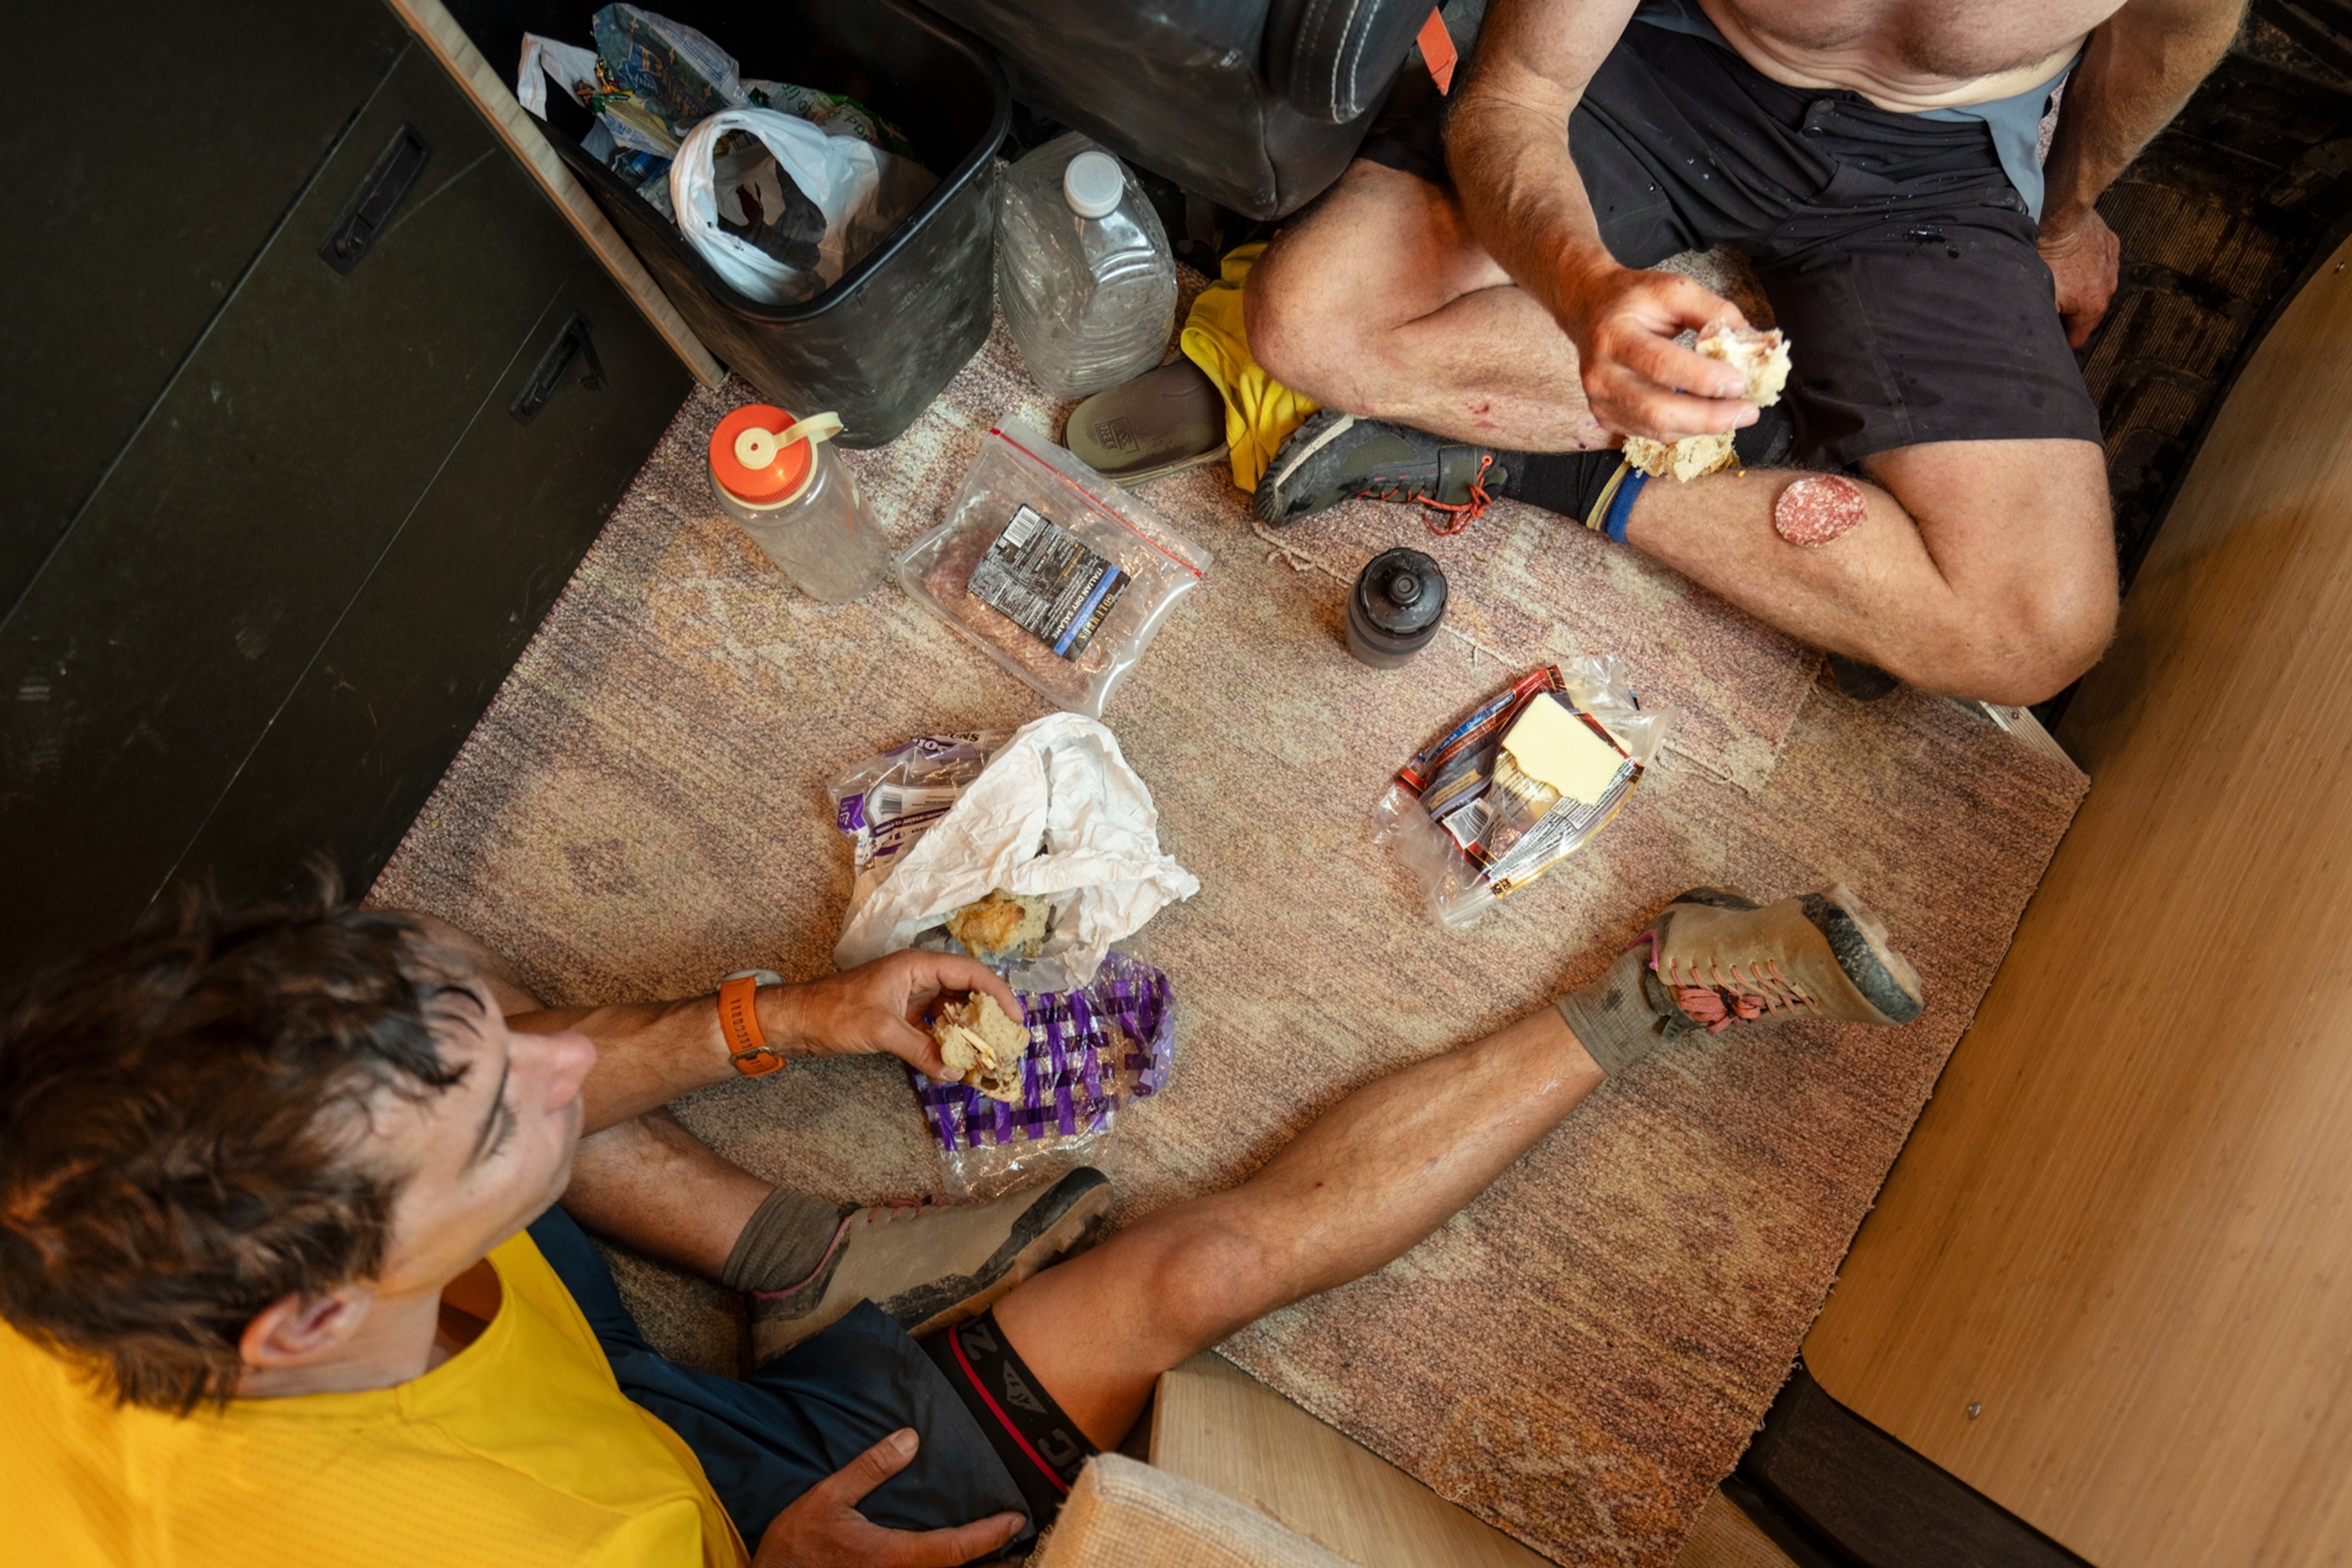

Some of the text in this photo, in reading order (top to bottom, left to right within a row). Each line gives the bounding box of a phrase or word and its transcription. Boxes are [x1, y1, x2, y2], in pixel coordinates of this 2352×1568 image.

[1080, 566, 1103, 596] ITALIAN
[1070, 594, 1084, 611] DRY
[1070, 585, 1107, 636] REDUCED SODIUM
[1077, 591, 1116, 642] COLUMBUS
[1050, 609, 1074, 640] SALAME
